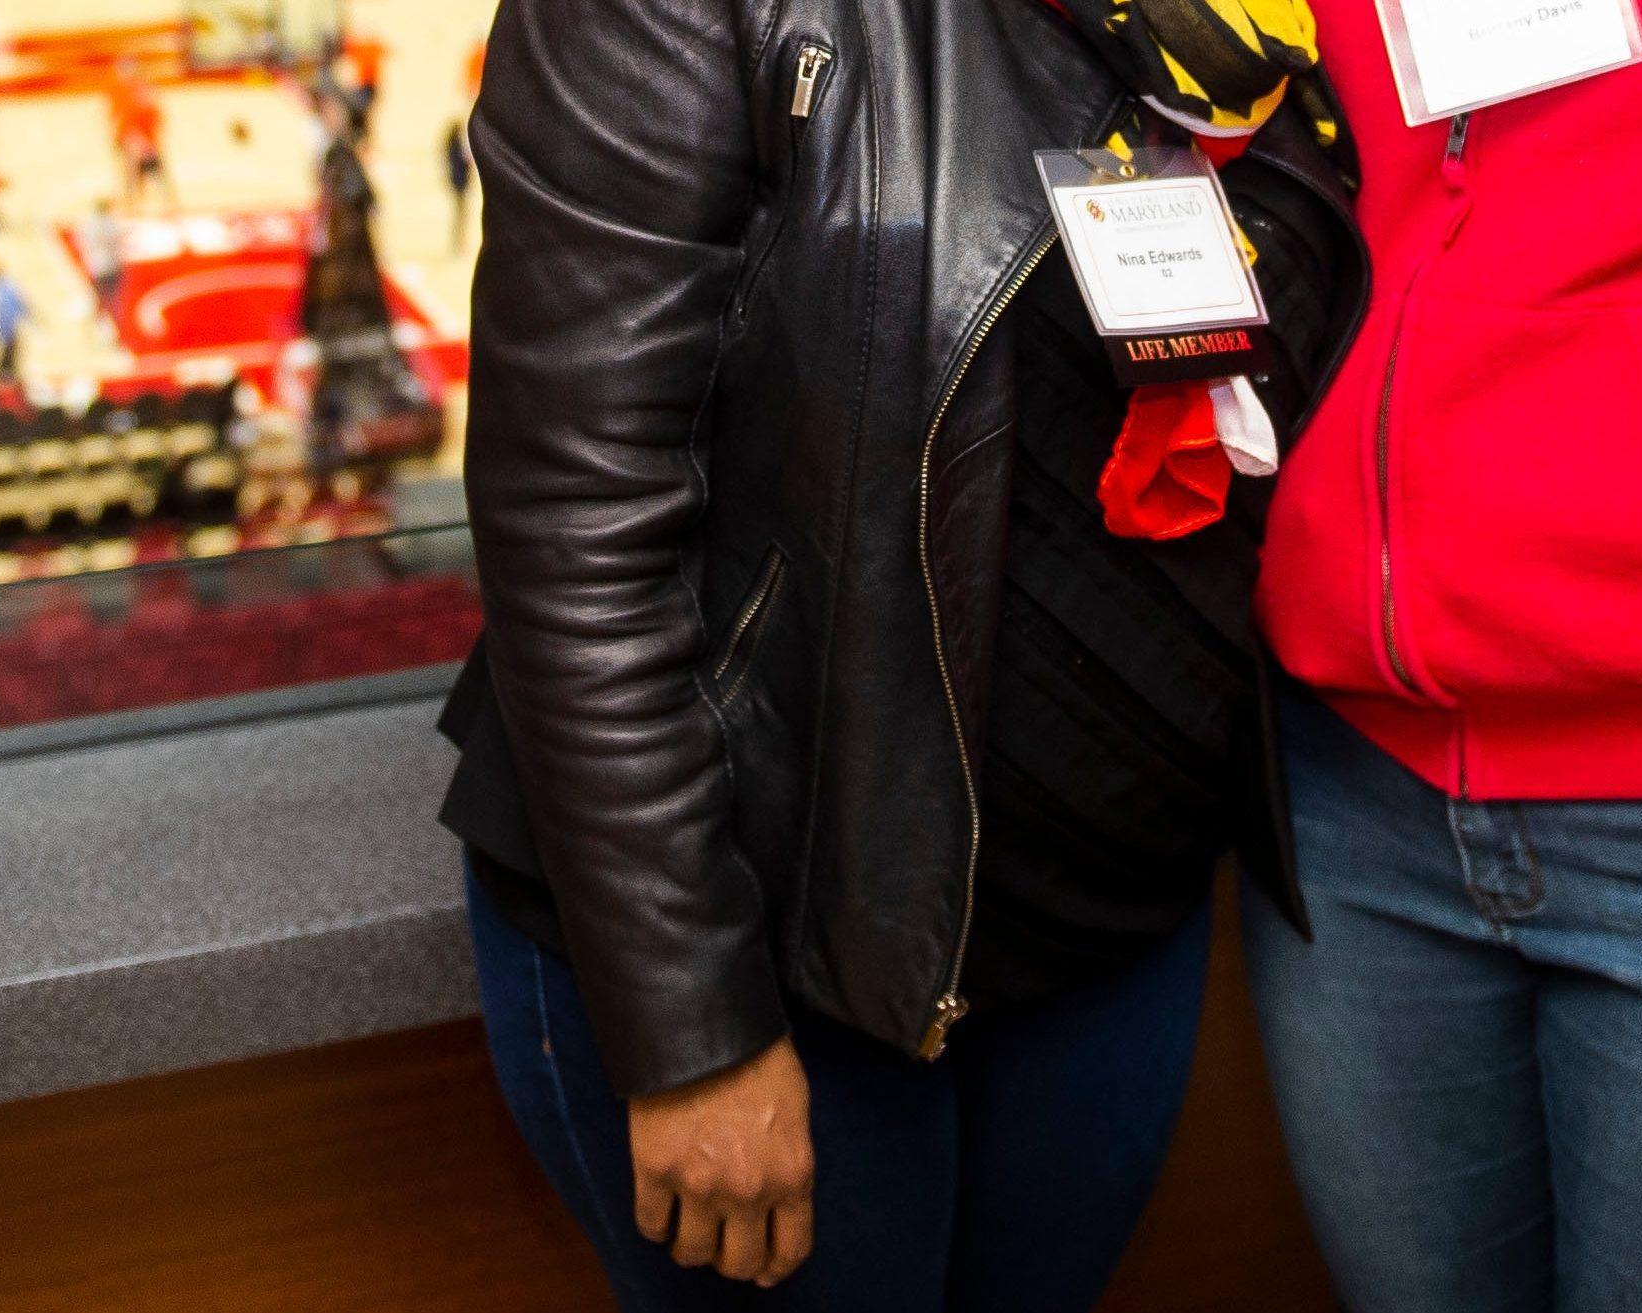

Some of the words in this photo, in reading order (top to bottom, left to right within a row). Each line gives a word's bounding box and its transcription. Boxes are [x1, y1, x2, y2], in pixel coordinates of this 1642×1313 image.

[1109, 200, 1202, 223] MARYLAND
[1117, 252, 1146, 266] Nina
[1148, 247, 1203, 264] Edwards
[1126, 341, 1169, 361] LIFE
[1169, 331, 1252, 357] MEMBER
